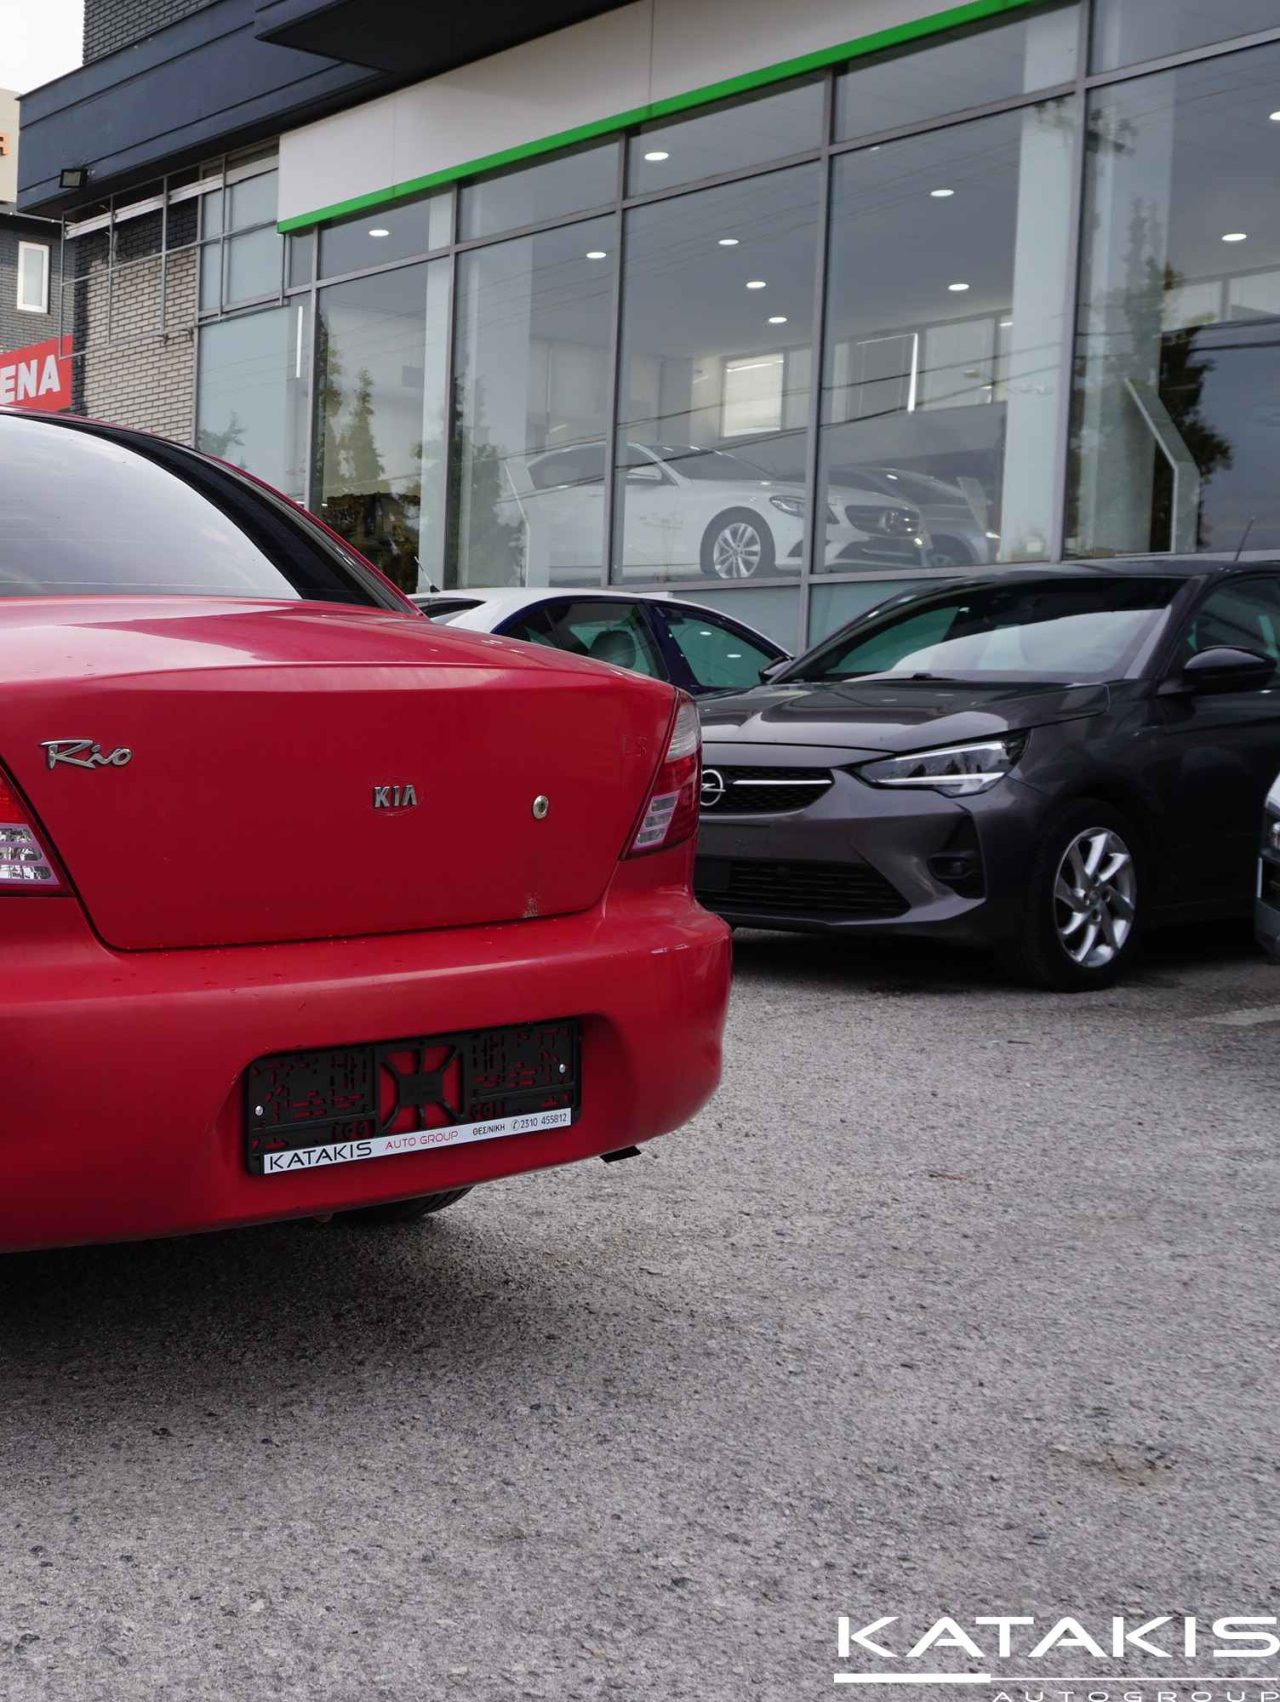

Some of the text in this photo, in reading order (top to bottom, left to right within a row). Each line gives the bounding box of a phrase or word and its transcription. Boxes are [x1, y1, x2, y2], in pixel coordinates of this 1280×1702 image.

[38, 737, 133, 770] Rio
[372, 784, 418, 808] KIA
[520, 1117, 538, 1129] 2310
[541, 1113, 567, 1125] 455812
[269, 1131, 459, 1171] KATAKIS AUTO GROUP
